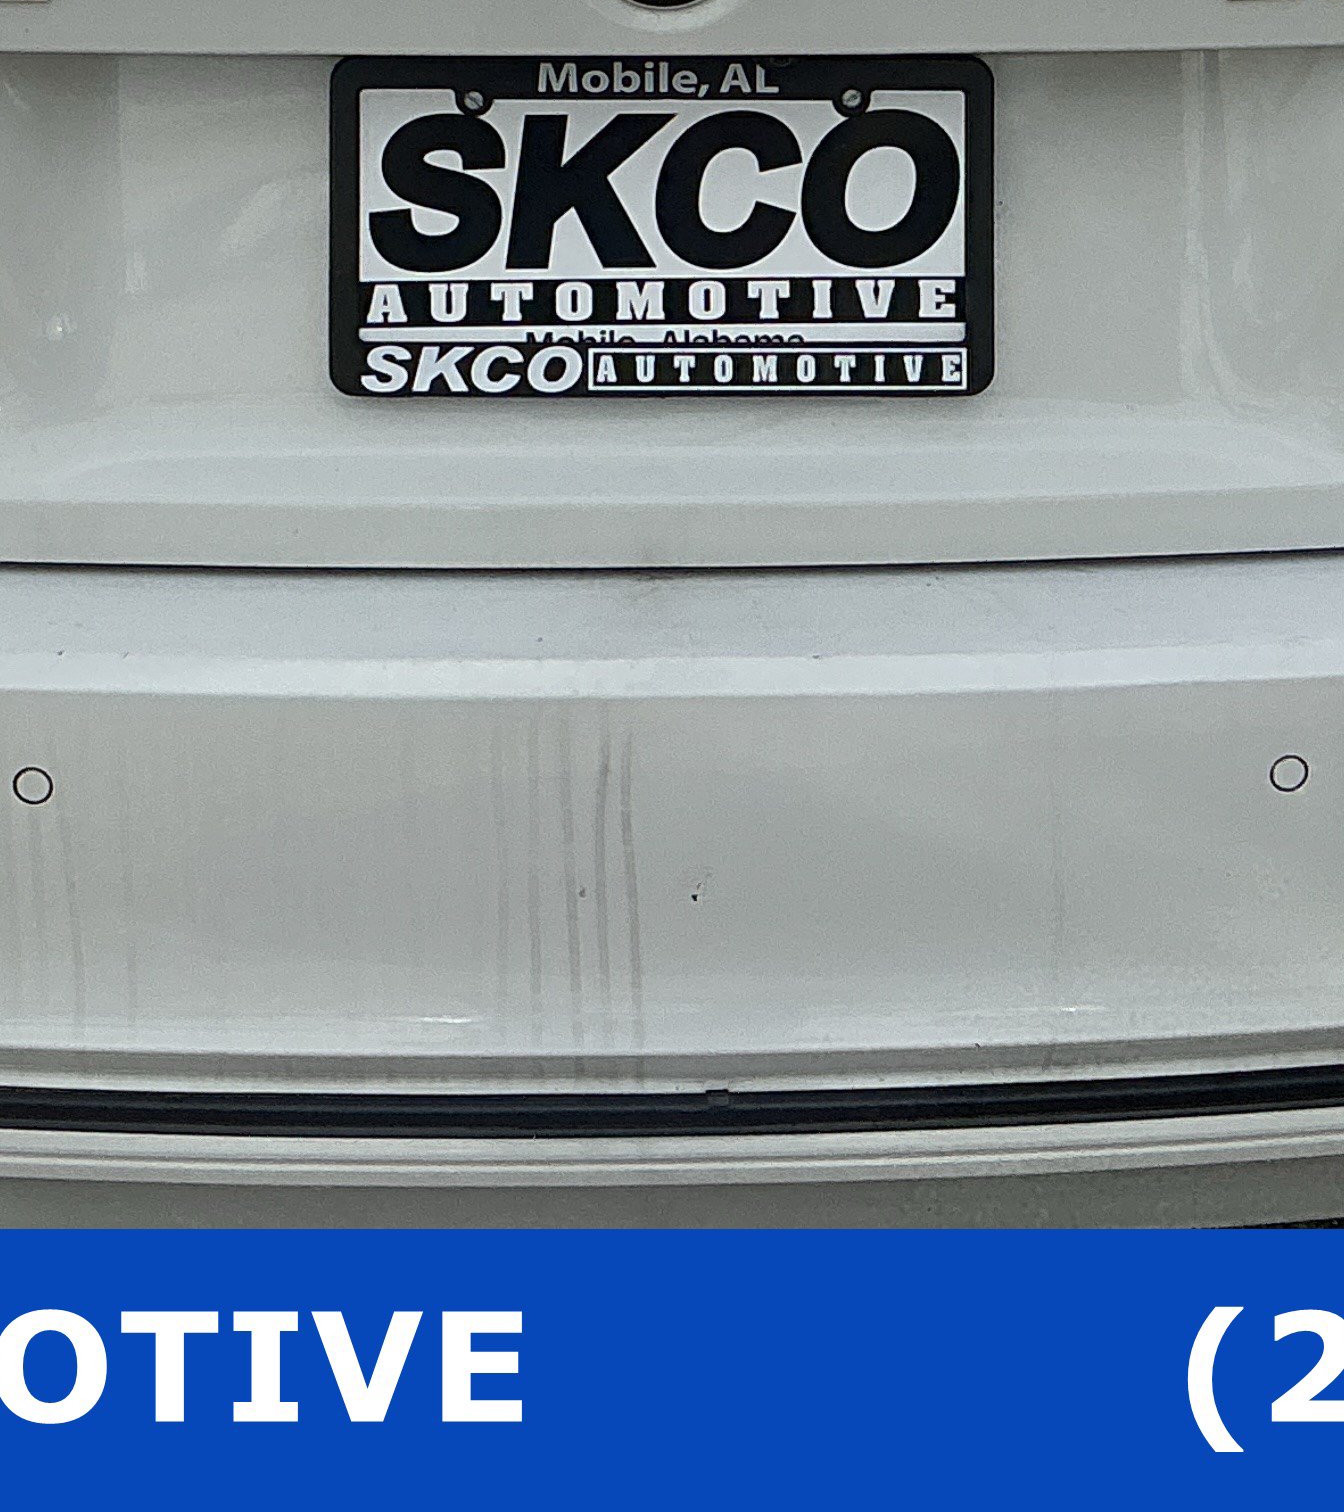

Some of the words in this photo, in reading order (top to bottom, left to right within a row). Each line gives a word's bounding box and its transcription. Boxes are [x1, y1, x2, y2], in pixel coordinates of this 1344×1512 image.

[538, 62, 708, 97] Mobile,
[722, 63, 779, 94] AL
[368, 109, 961, 273] SKCO
[366, 280, 956, 323] AUTOMOTIVE
[360, 345, 583, 393] SKCO
[596, 354, 962, 384] AUTOMOTIVE
